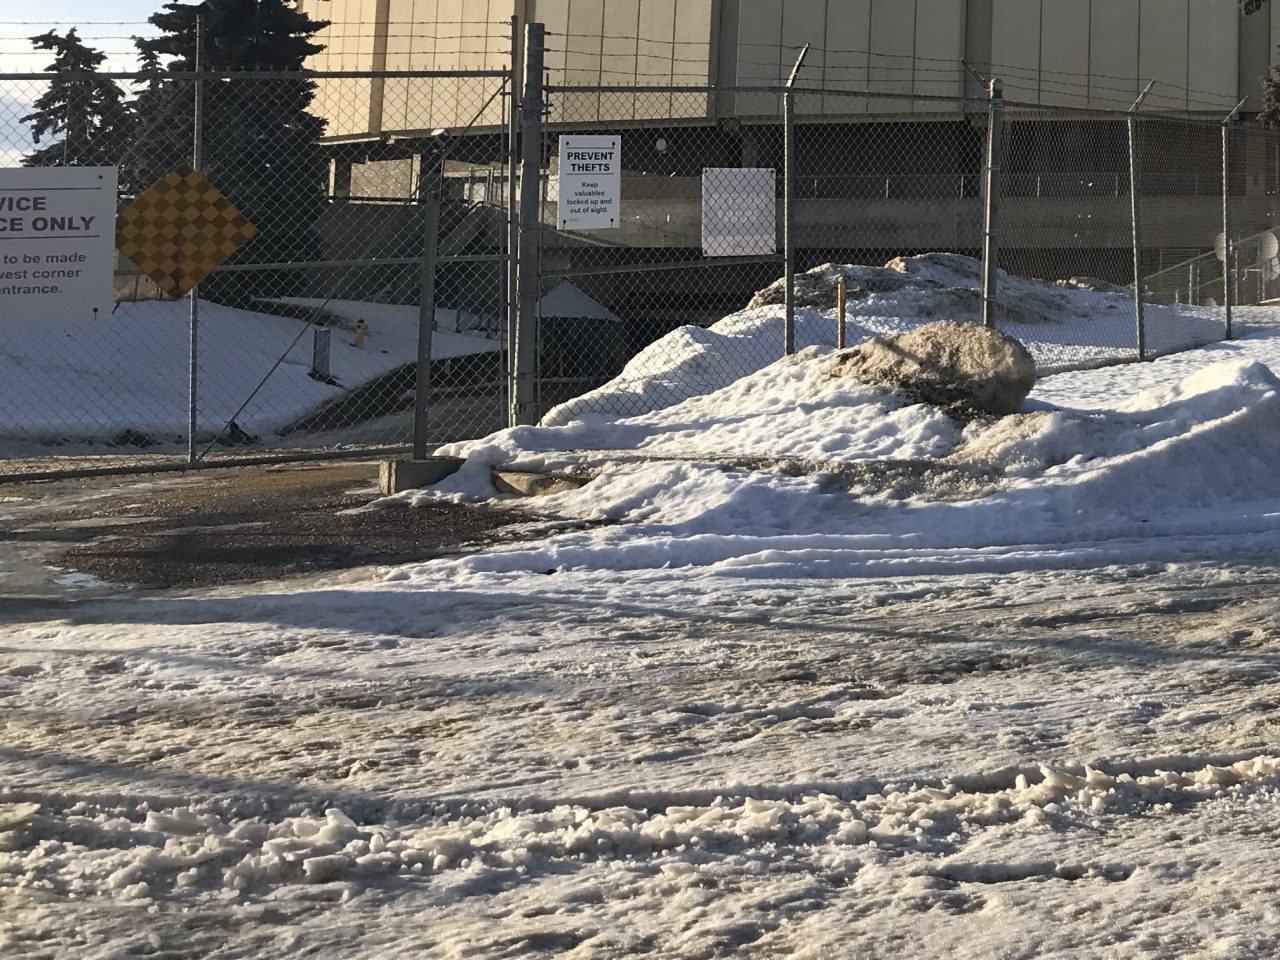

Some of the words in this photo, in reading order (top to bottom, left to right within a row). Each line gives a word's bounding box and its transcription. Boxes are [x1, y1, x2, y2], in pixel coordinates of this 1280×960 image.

[567, 152, 614, 160] PREVENT
[571, 163, 610, 171] THEFTS
[582, 181, 598, 189] Keep
[32, 216, 95, 231] ONLY
[3, 254, 18, 264] to
[23, 253, 41, 263] be
[45, 252, 87, 263] made
[32, 269, 82, 279] corner
[0, 285, 63, 295] ntrance.
